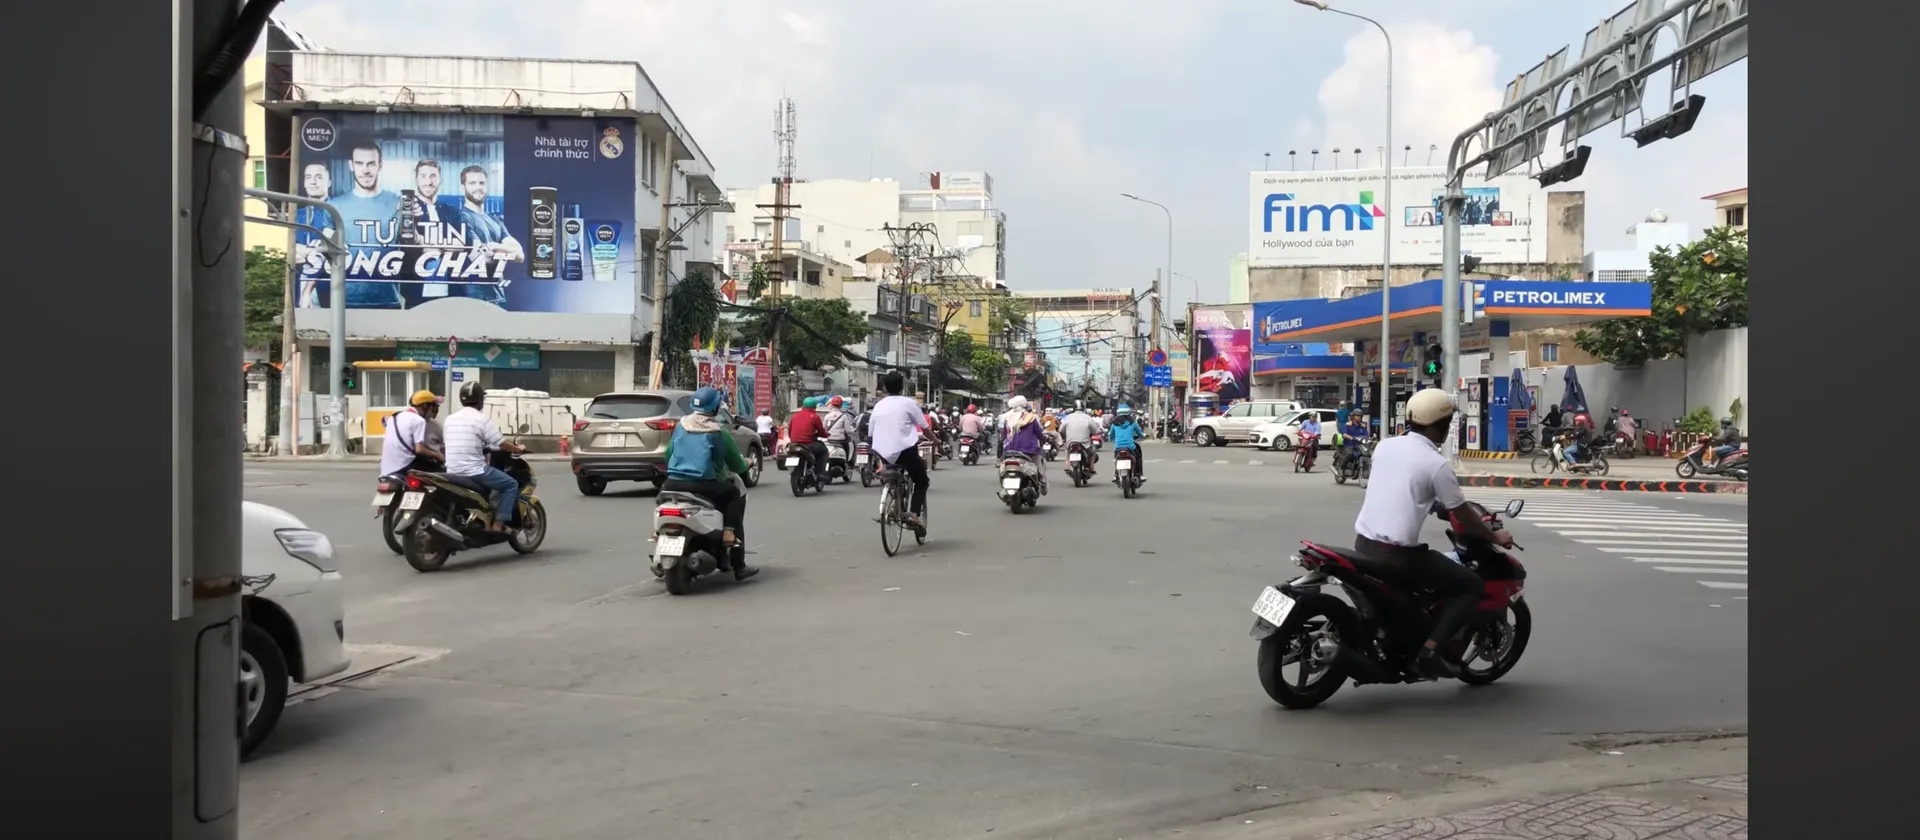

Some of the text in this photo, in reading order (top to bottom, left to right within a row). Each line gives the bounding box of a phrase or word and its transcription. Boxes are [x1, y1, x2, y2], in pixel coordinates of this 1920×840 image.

[535, 136, 588, 148] Nhà tài trợ
[534, 147, 589, 159] chính thức
[354, 217, 467, 247] TỰ TIN
[1263, 238, 1354, 249] Hollywood của bạn
[1494, 291, 1606, 304] PETROLIMEX
[1272, 317, 1302, 332] PETROLIMEX
